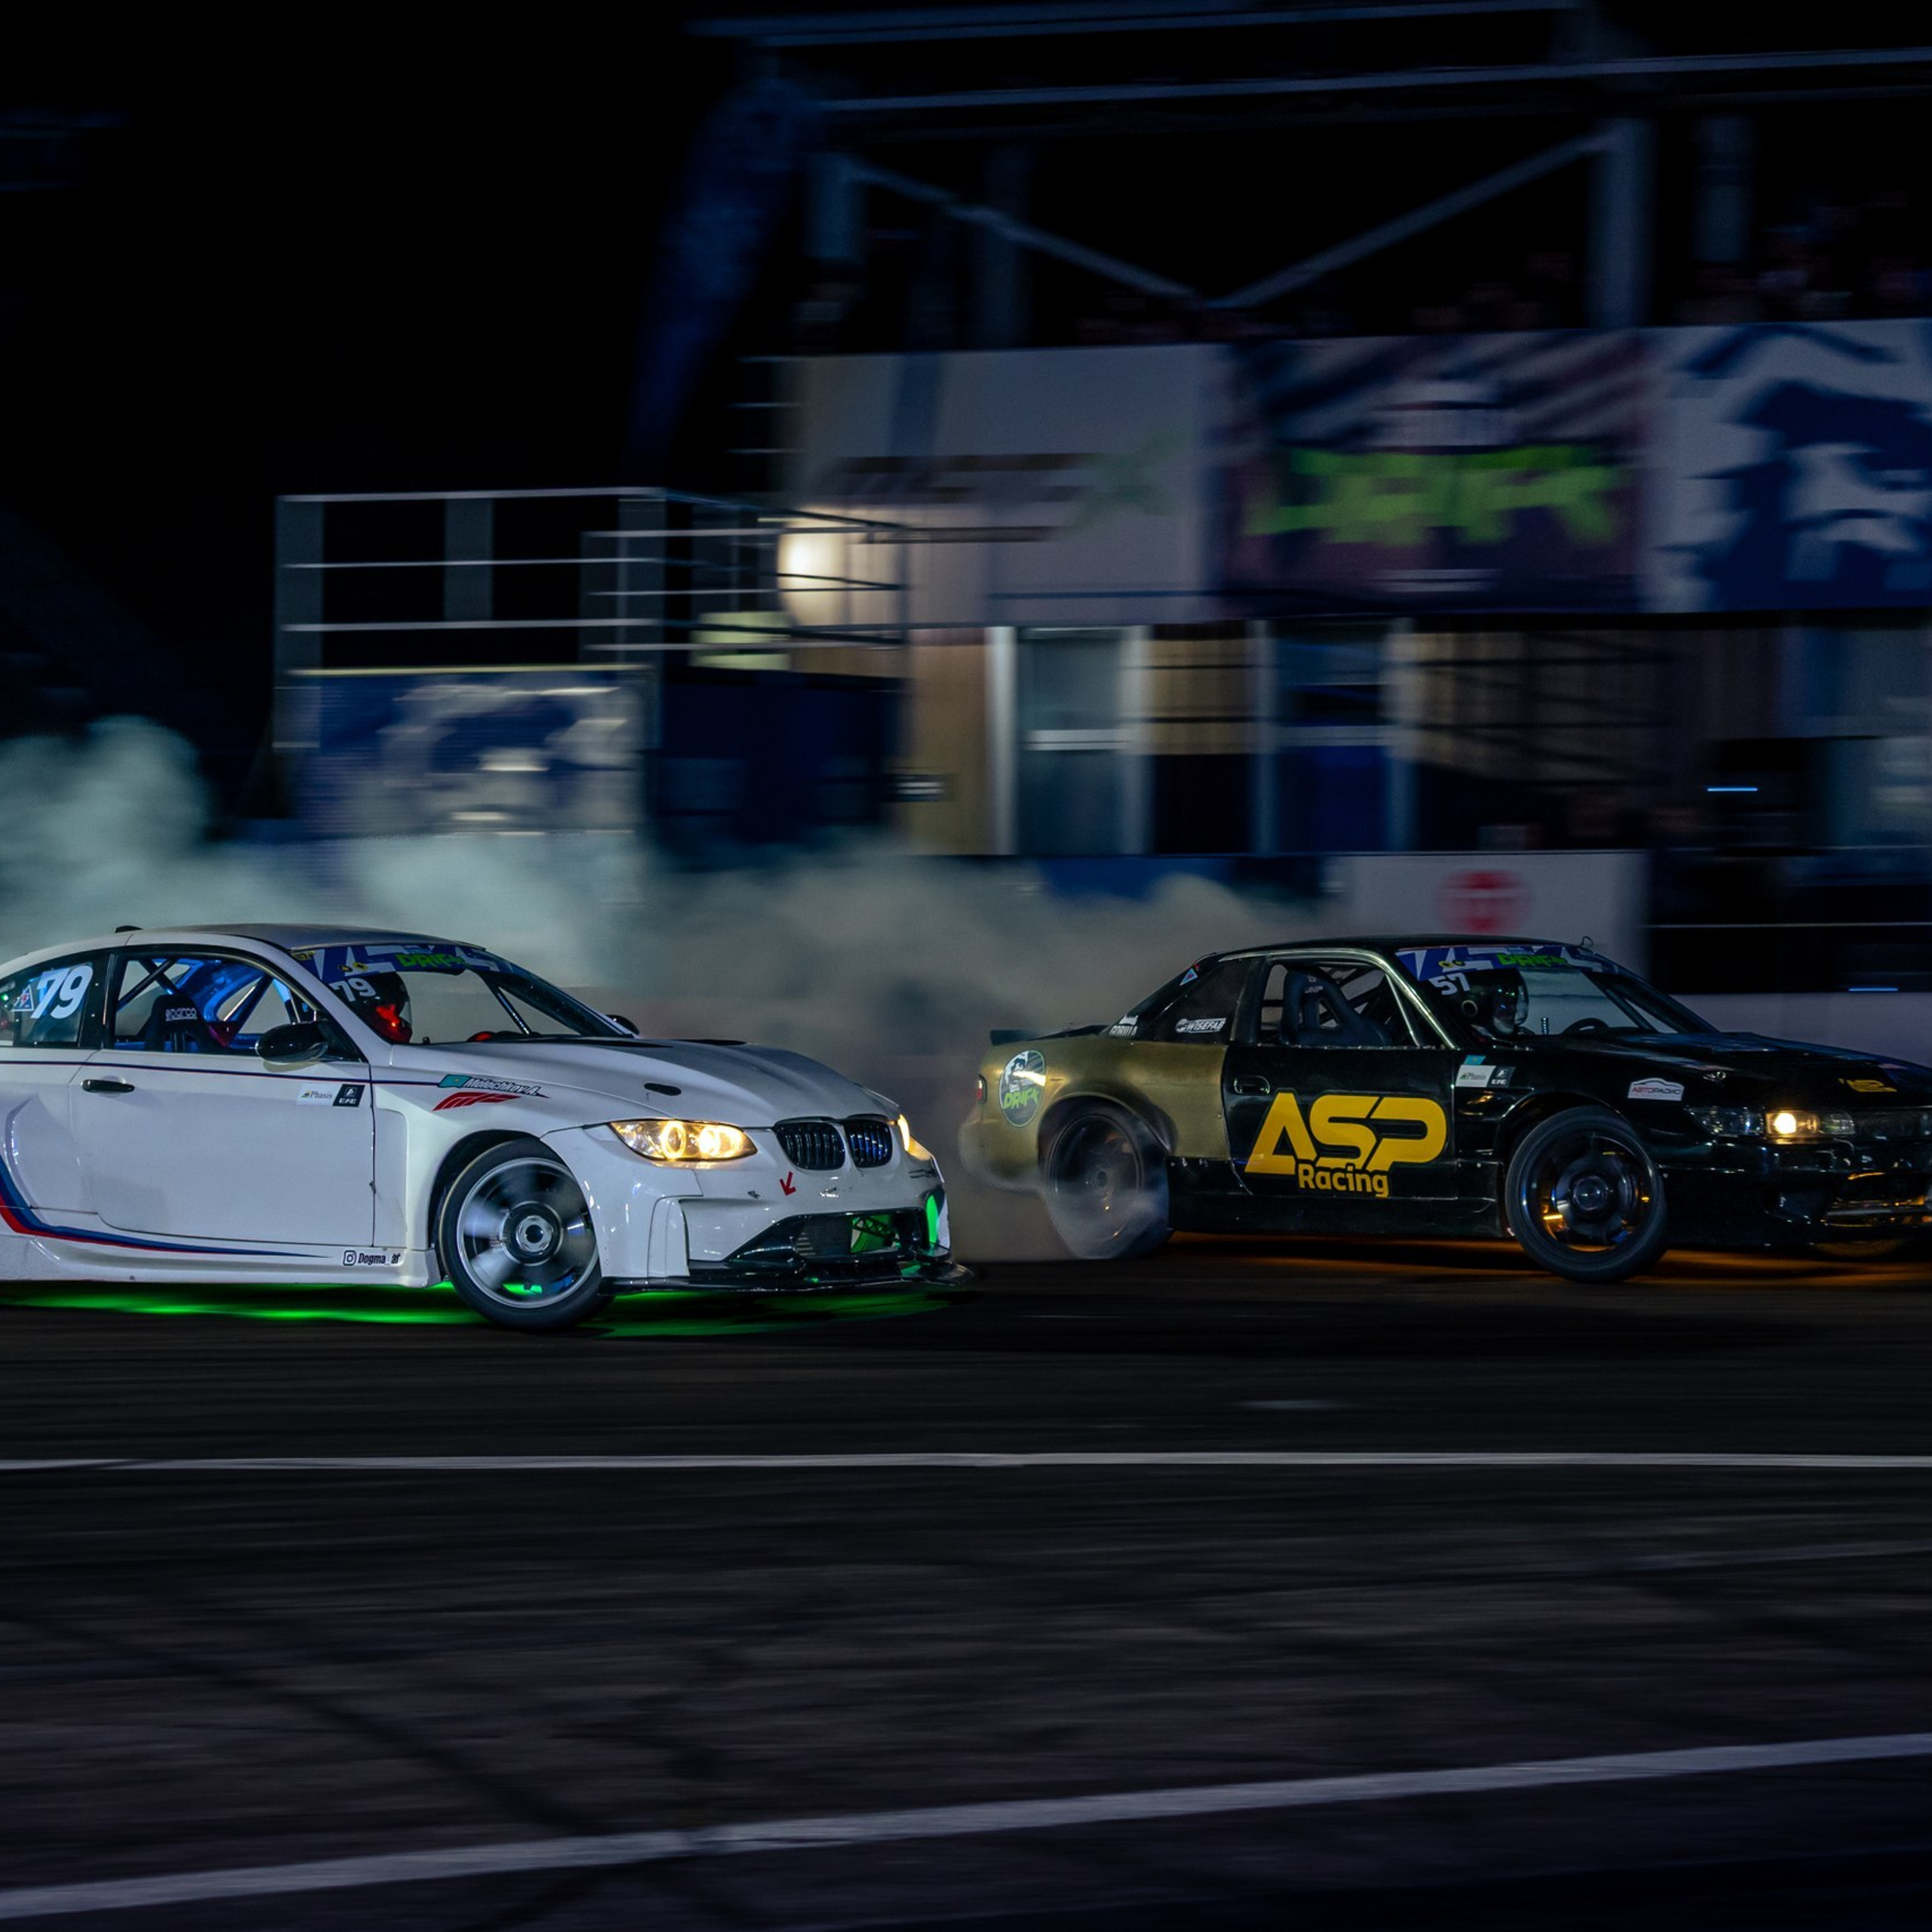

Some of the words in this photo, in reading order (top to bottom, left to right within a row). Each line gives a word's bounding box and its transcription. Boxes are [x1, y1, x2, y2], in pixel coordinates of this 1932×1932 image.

[30, 965, 94, 1020] 79
[328, 977, 377, 1002] 79
[1429, 972, 1471, 996] 57
[1245, 1092, 1447, 1175] ASP
[1297, 1162, 1390, 1198] Racing
